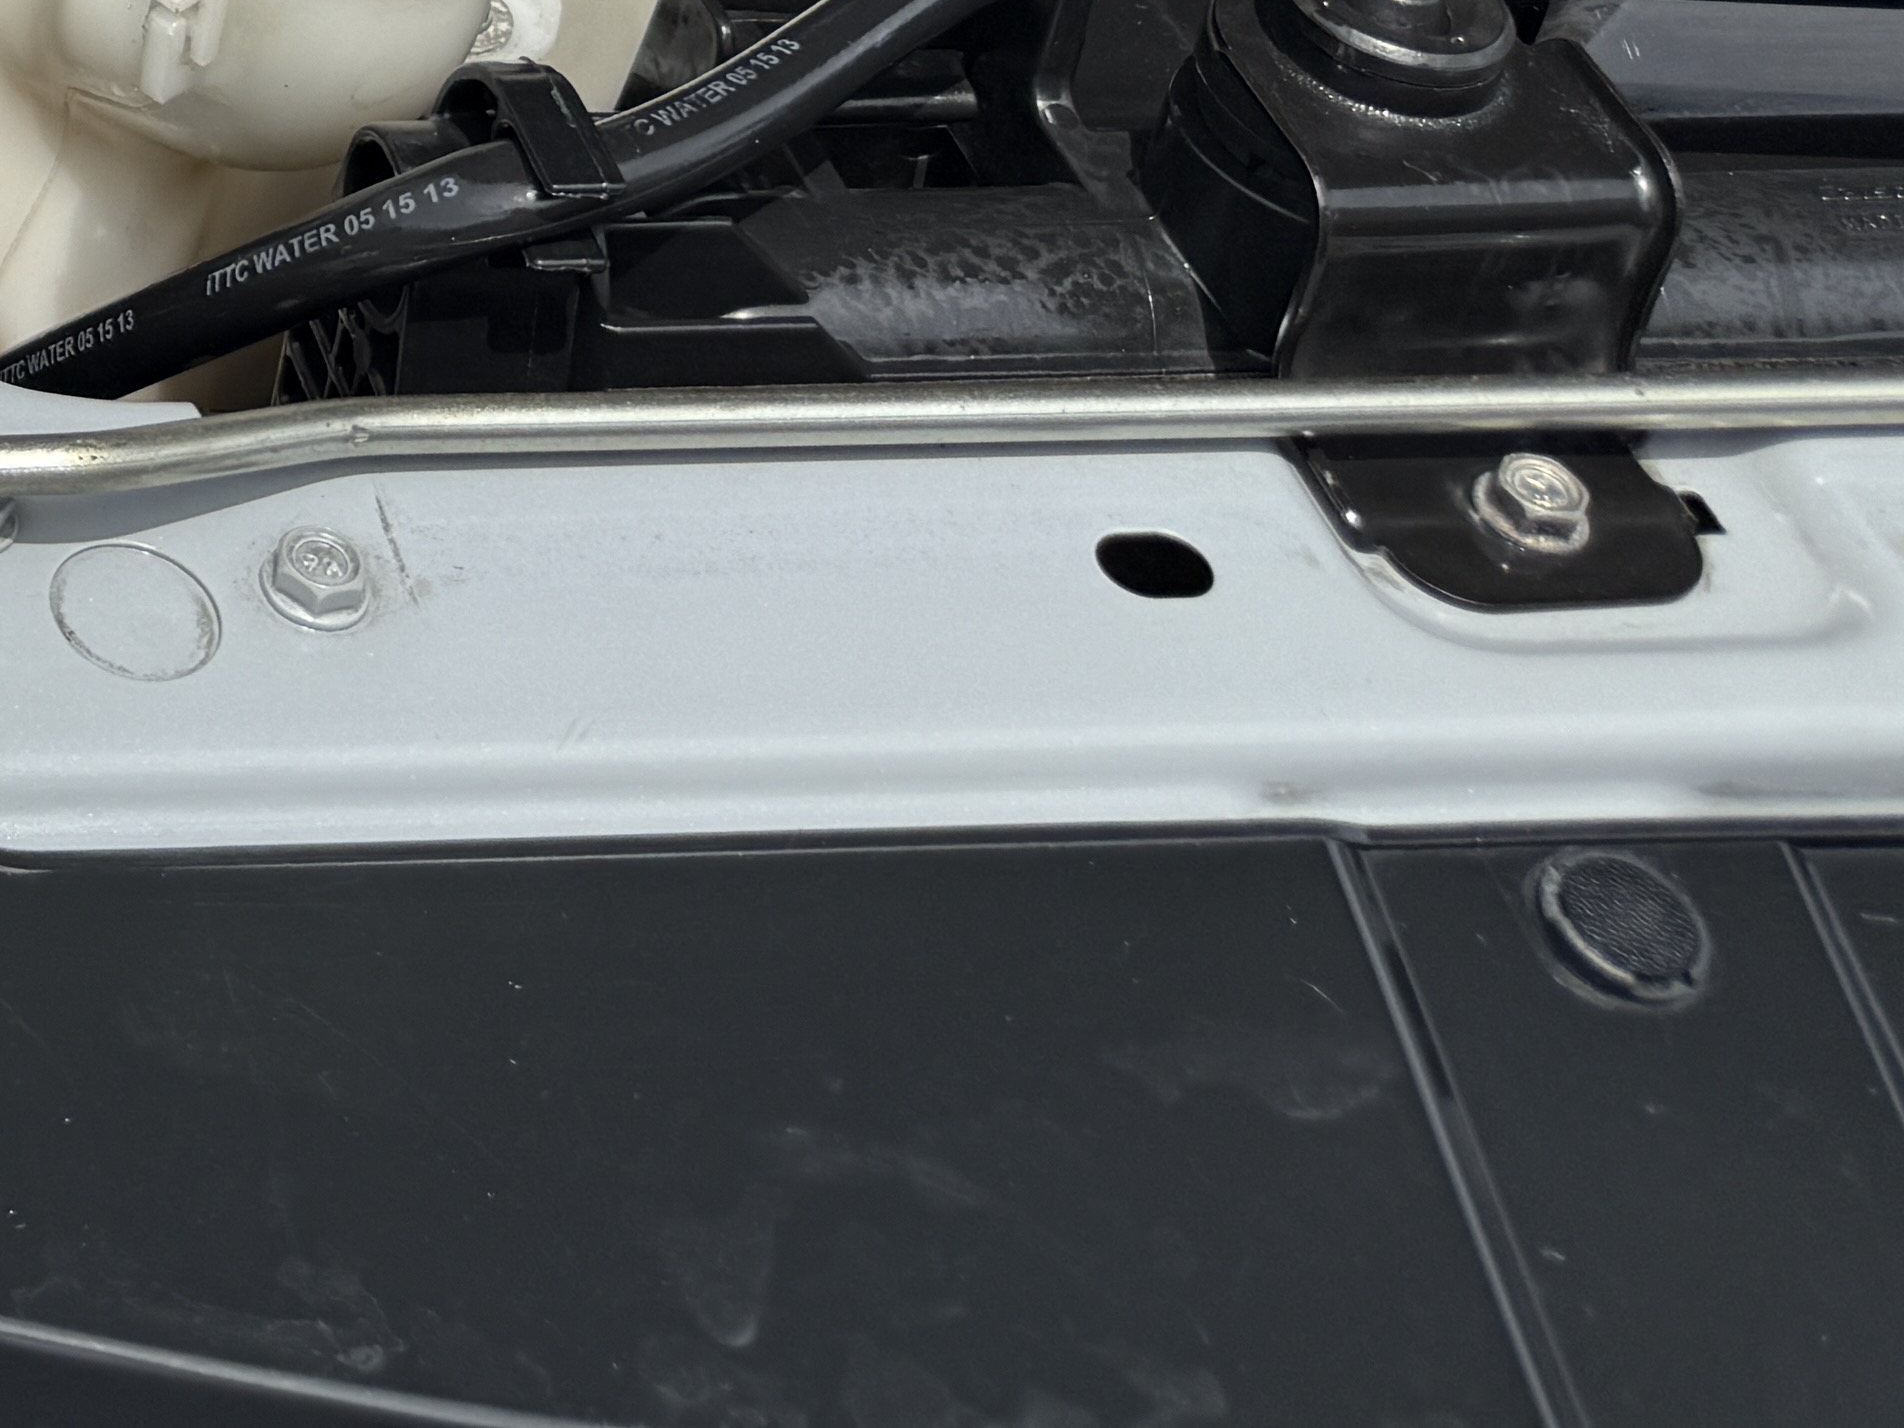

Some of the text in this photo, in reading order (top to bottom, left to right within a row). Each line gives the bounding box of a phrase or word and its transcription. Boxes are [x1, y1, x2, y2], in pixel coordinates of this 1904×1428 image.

[650, 38, 802, 126] WATER 05 15 13
[253, 223, 341, 275] WATER
[343, 207, 376, 236] 05
[382, 192, 417, 220] 15
[423, 177, 460, 203] 13
[26, 336, 76, 375] WATER
[77, 327, 94, 352] 05
[97, 318, 115, 343] 15
[117, 309, 135, 334] 13
